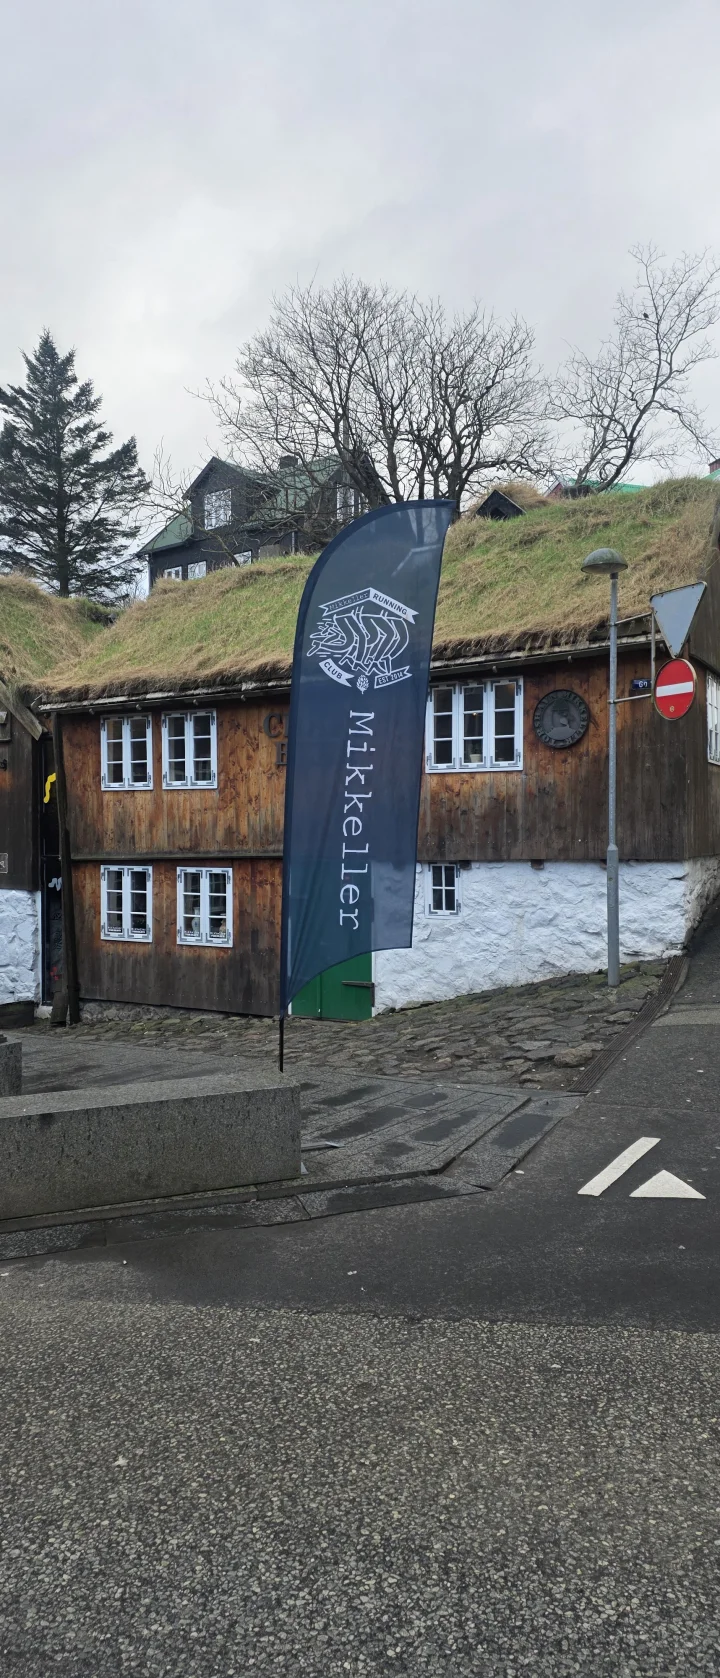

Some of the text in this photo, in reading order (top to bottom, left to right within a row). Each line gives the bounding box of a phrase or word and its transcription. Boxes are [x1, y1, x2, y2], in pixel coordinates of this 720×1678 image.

[328, 592, 408, 616] Mikkeller RUNNING
[323, 661, 343, 680] CLUB
[378, 671, 404, 685] EST 2014
[340, 710, 376, 930] Mikkeller
